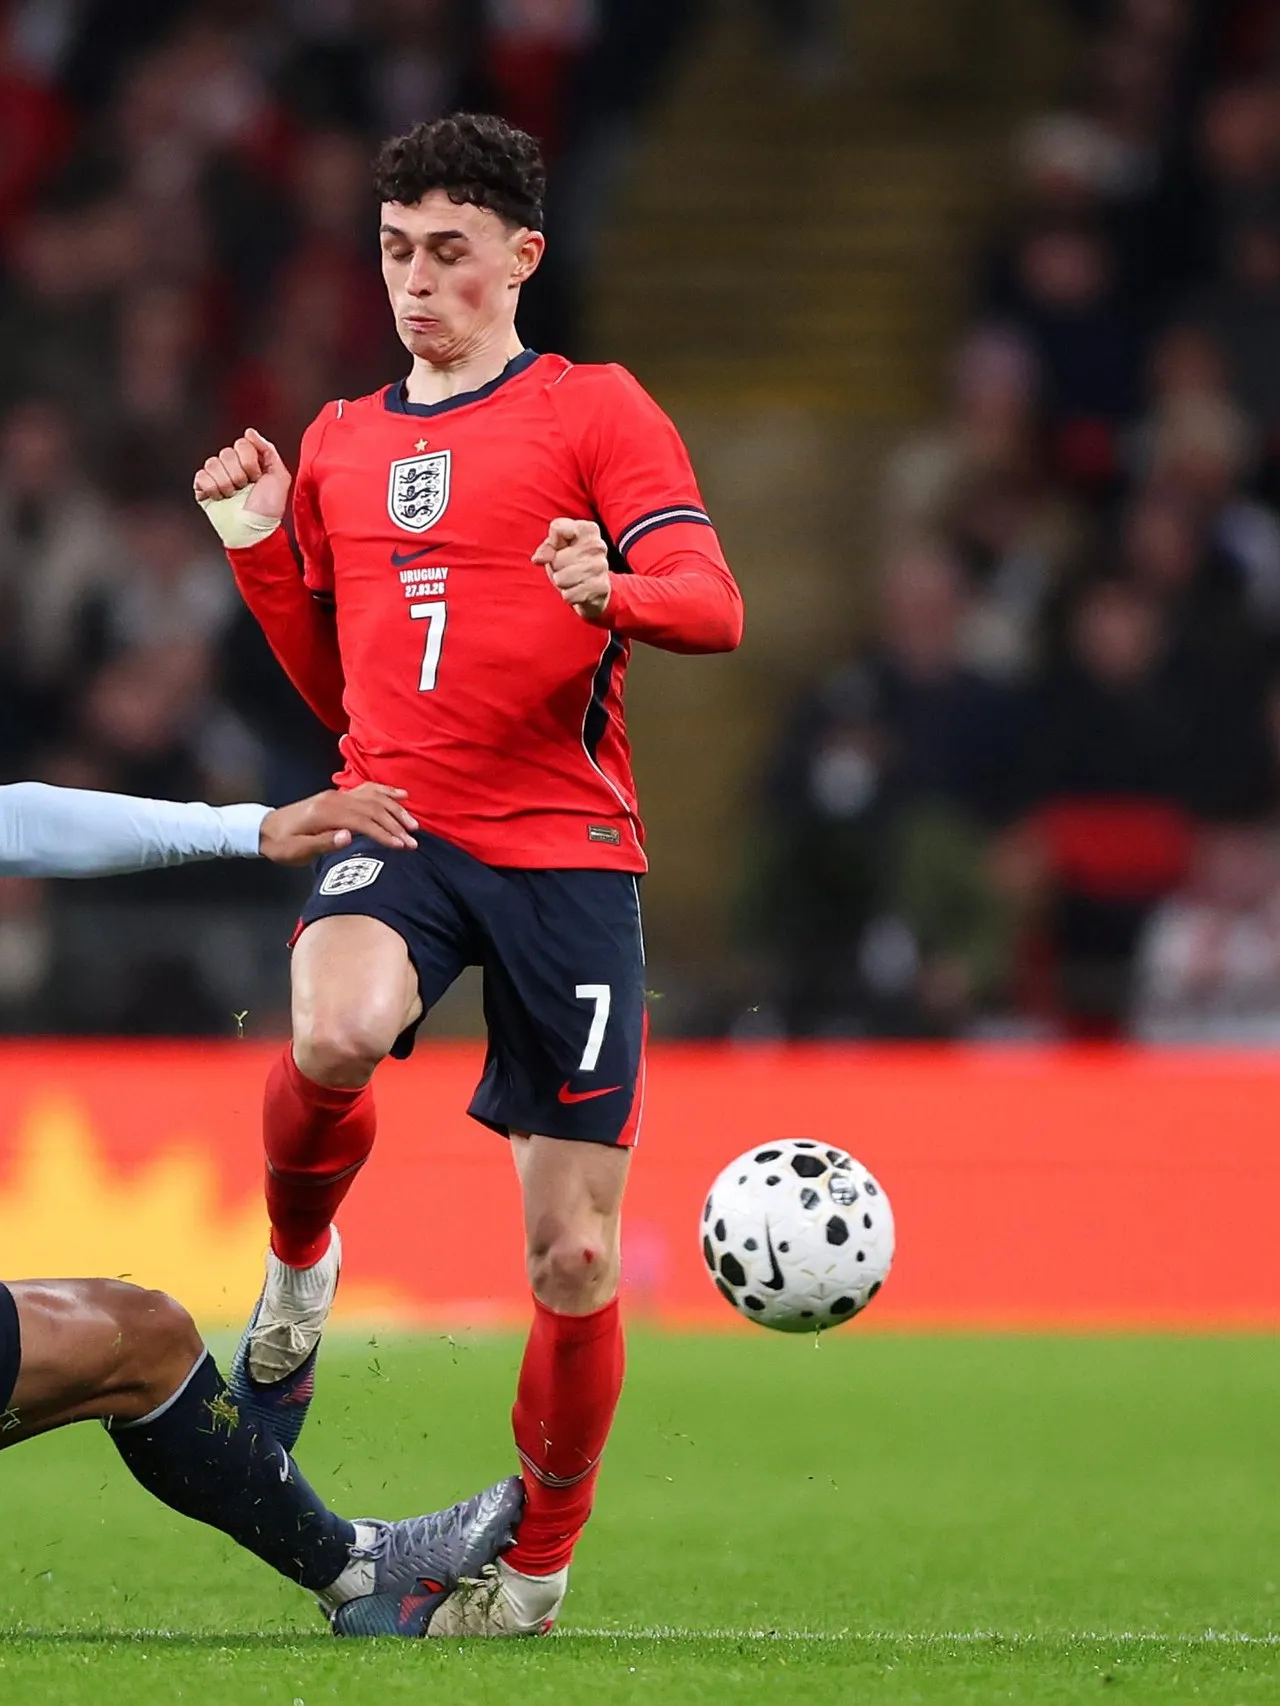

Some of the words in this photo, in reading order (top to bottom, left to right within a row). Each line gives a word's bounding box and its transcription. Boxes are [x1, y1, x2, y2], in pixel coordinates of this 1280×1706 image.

[399, 567, 448, 583] URUGUAY
[410, 600, 447, 691] 7
[575, 984, 611, 1071] 7
